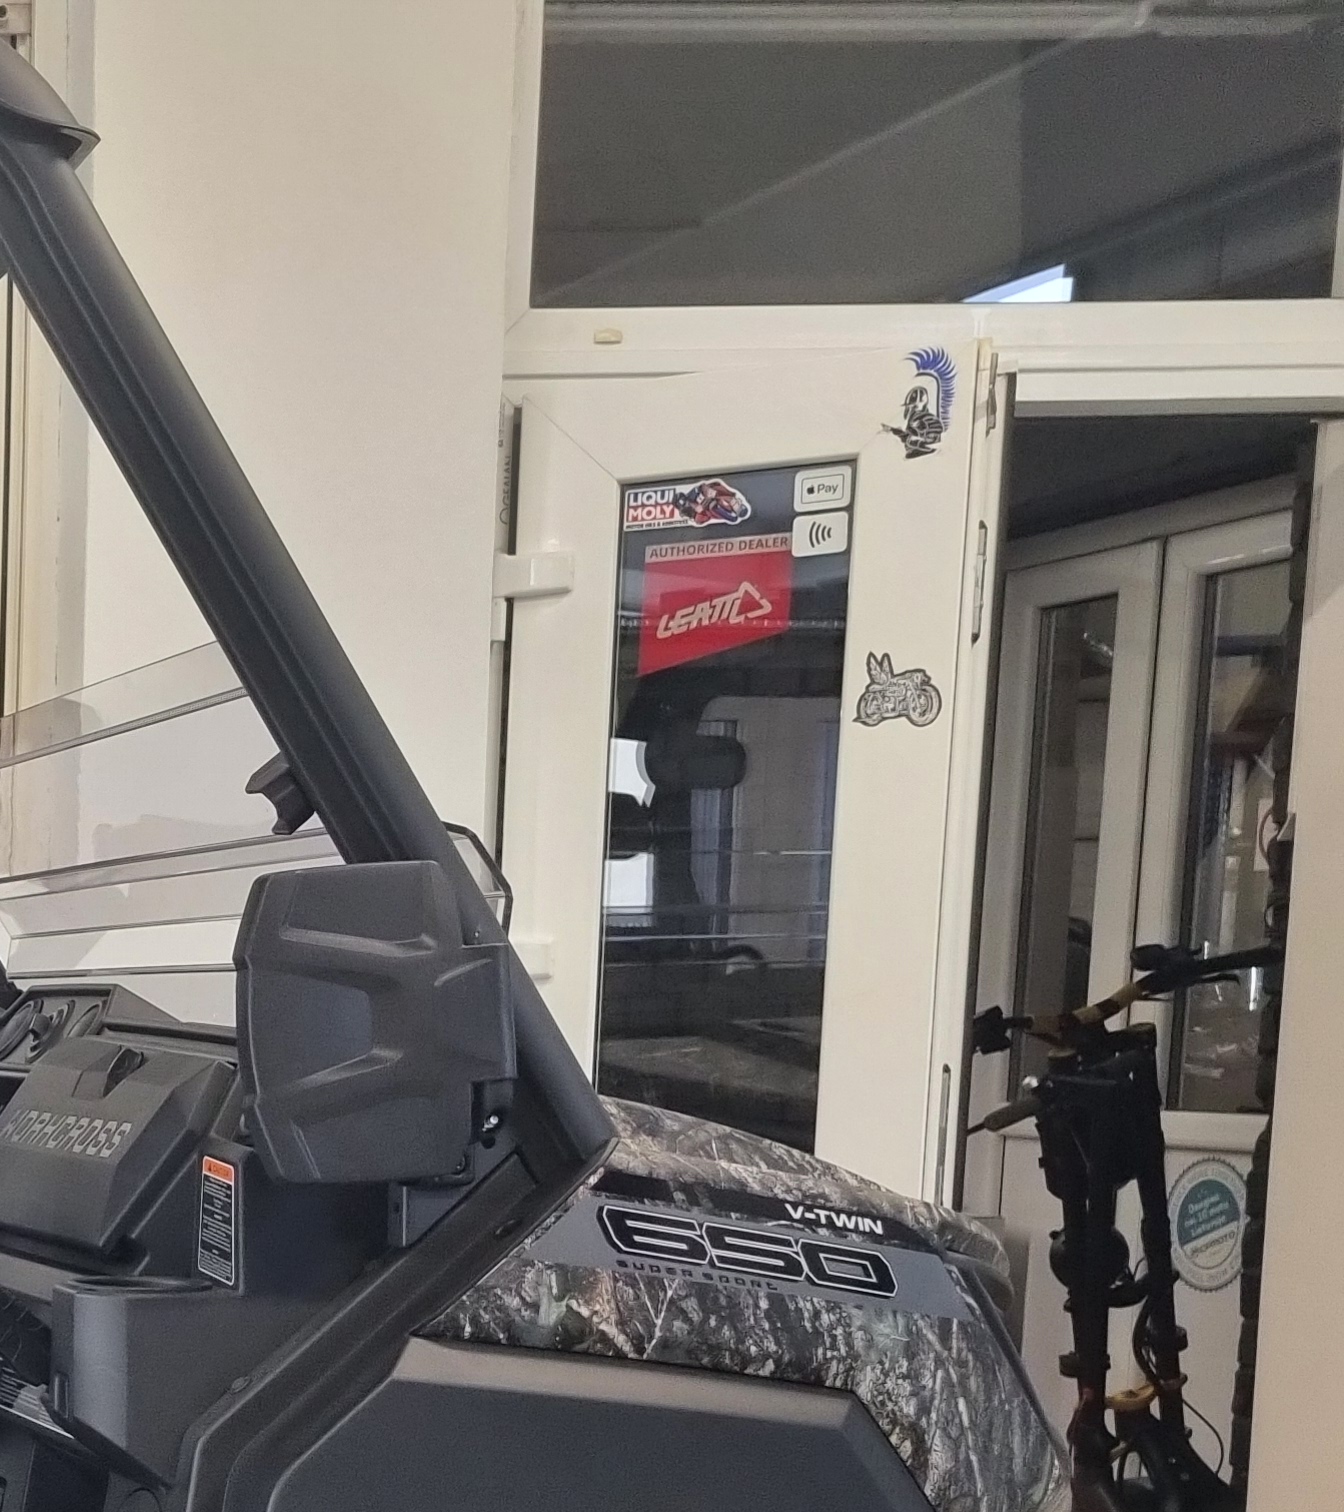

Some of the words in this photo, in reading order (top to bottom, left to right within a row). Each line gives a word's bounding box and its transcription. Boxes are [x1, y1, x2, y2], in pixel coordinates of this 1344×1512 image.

[629, 489, 674, 507] LIQUI
[817, 483, 839, 495] Pay
[628, 504, 674, 522] MOLY
[649, 541, 734, 559] AUTHORIZED
[738, 536, 789, 551] DEALER
[784, 1203, 884, 1236] V-TWIN
[596, 1204, 899, 1299] 650
